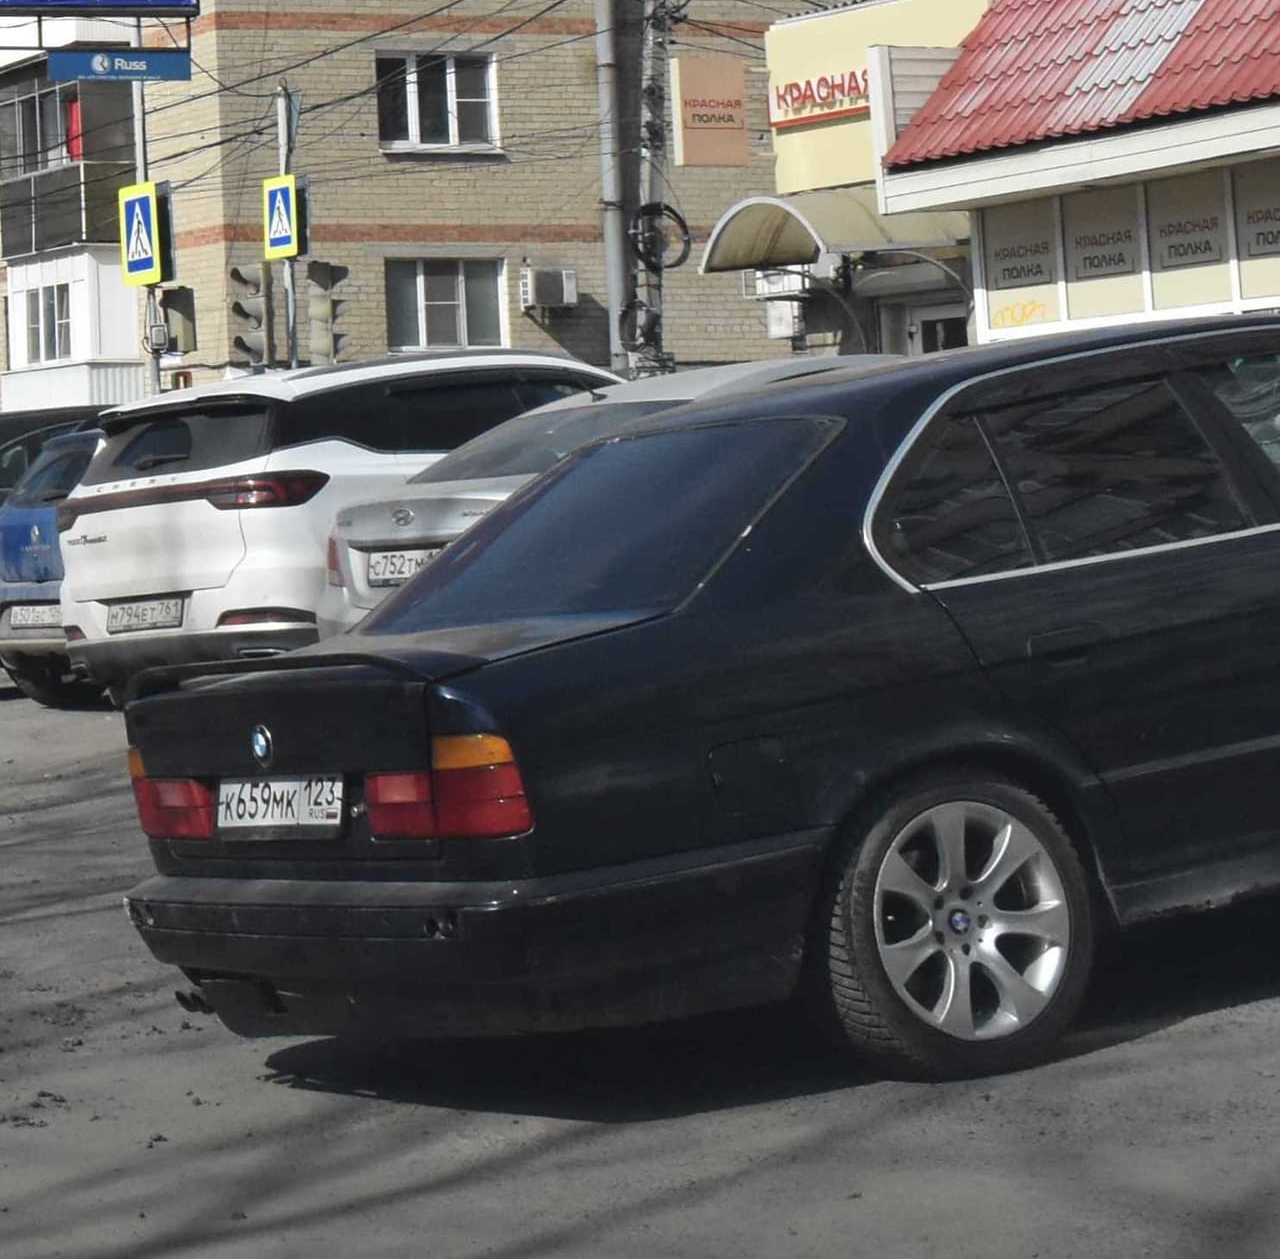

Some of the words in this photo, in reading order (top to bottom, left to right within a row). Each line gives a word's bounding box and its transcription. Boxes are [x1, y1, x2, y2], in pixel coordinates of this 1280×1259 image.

[114, 58, 147, 71] Russ
[684, 99, 742, 110] КРАСНАЯ
[692, 112, 735, 124] ПОЛКА
[1159, 217, 1220, 238] КРАСНАЯ
[1075, 229, 1132, 249] КРАСНАЯ
[994, 242, 1050, 260] КРАСНАЯ
[1167, 240, 1213, 259] ПОЛКА
[1082, 252, 1126, 270] ПОЛКА
[1002, 263, 1044, 280] ПОЛКА
[224, 782, 297, 821] К659МК
[304, 778, 336, 807] 123
[309, 808, 326, 820] RUS
